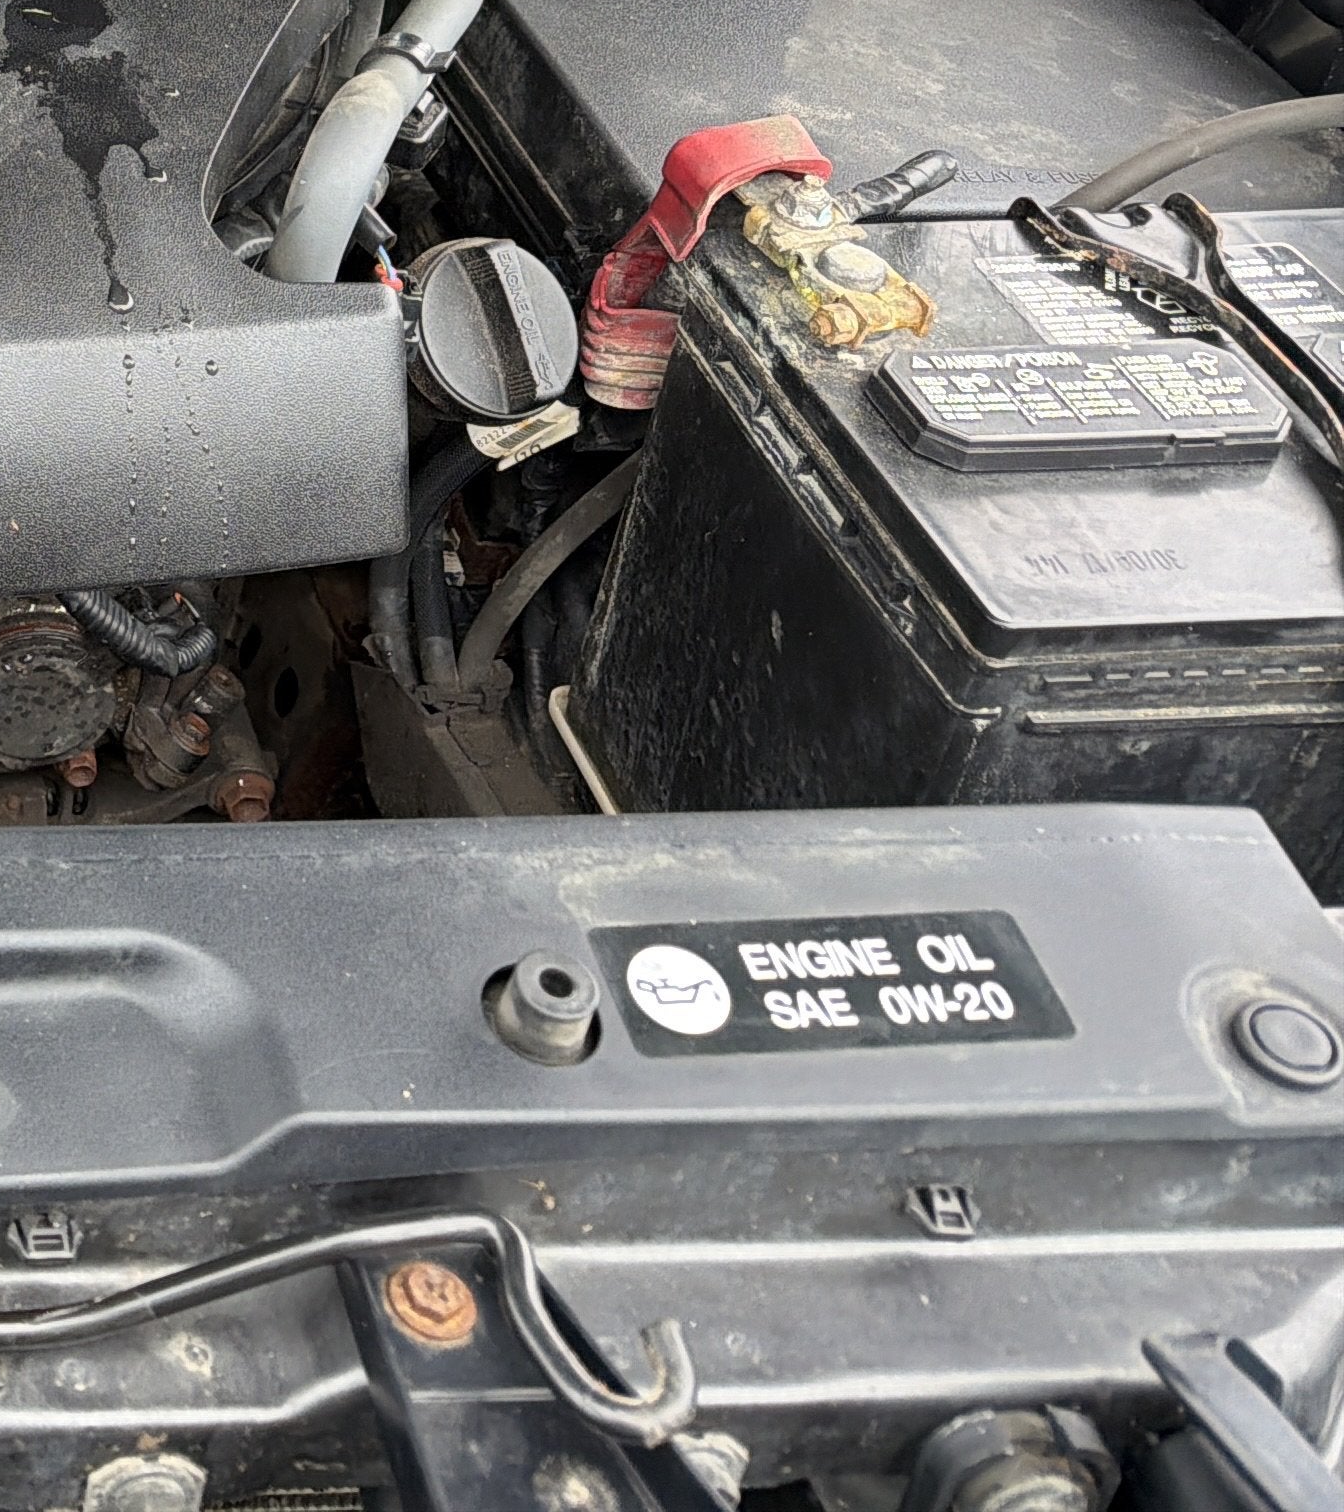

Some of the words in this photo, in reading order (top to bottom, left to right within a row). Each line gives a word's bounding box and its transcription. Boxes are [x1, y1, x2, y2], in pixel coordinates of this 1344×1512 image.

[952, 169, 1013, 184] RELAY
[497, 250, 530, 315] ENGINE
[520, 317, 543, 346] OIL
[738, 937, 901, 981] ENGINE
[916, 933, 996, 974] OIL
[763, 987, 861, 1030] SAE
[878, 980, 1015, 1025] 0W-20
